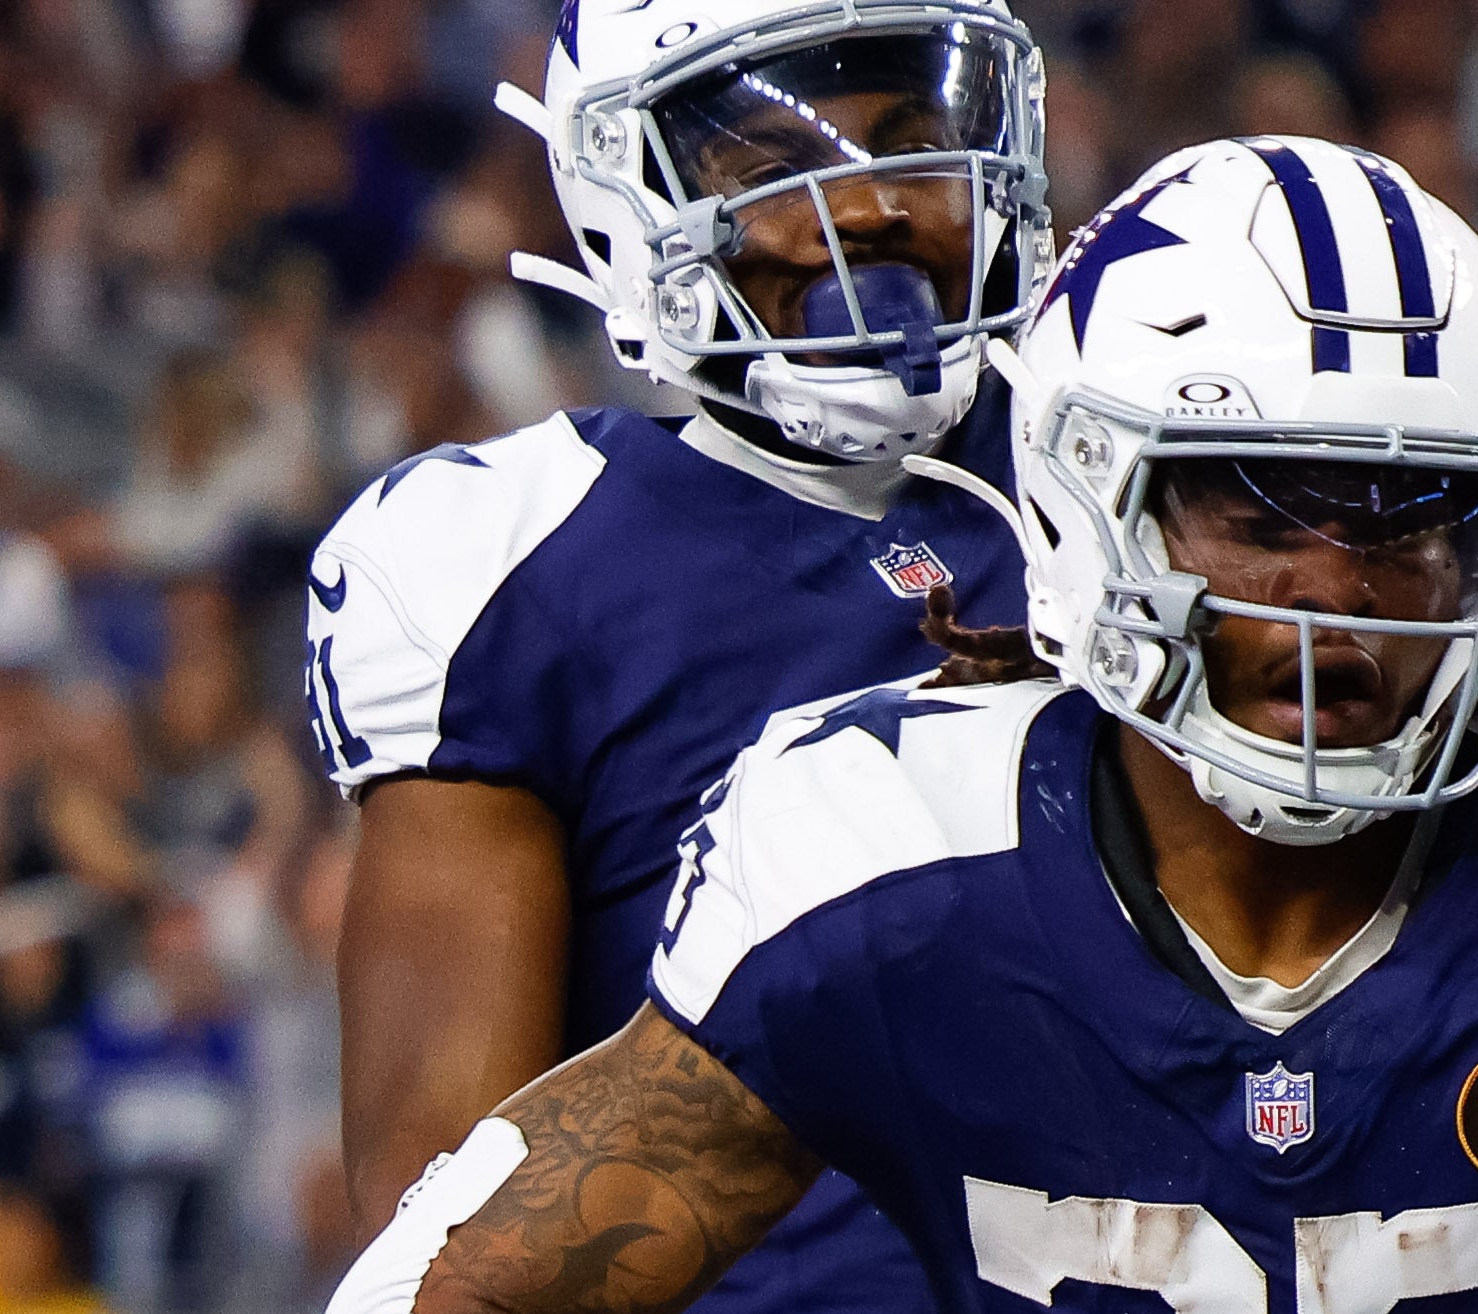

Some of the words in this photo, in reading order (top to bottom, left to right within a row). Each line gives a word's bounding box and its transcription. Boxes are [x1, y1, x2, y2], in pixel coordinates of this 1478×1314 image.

[1165, 407, 1246, 417] OAKLEY
[896, 562, 941, 588] NFL
[1258, 1105, 1304, 1137] NFL
